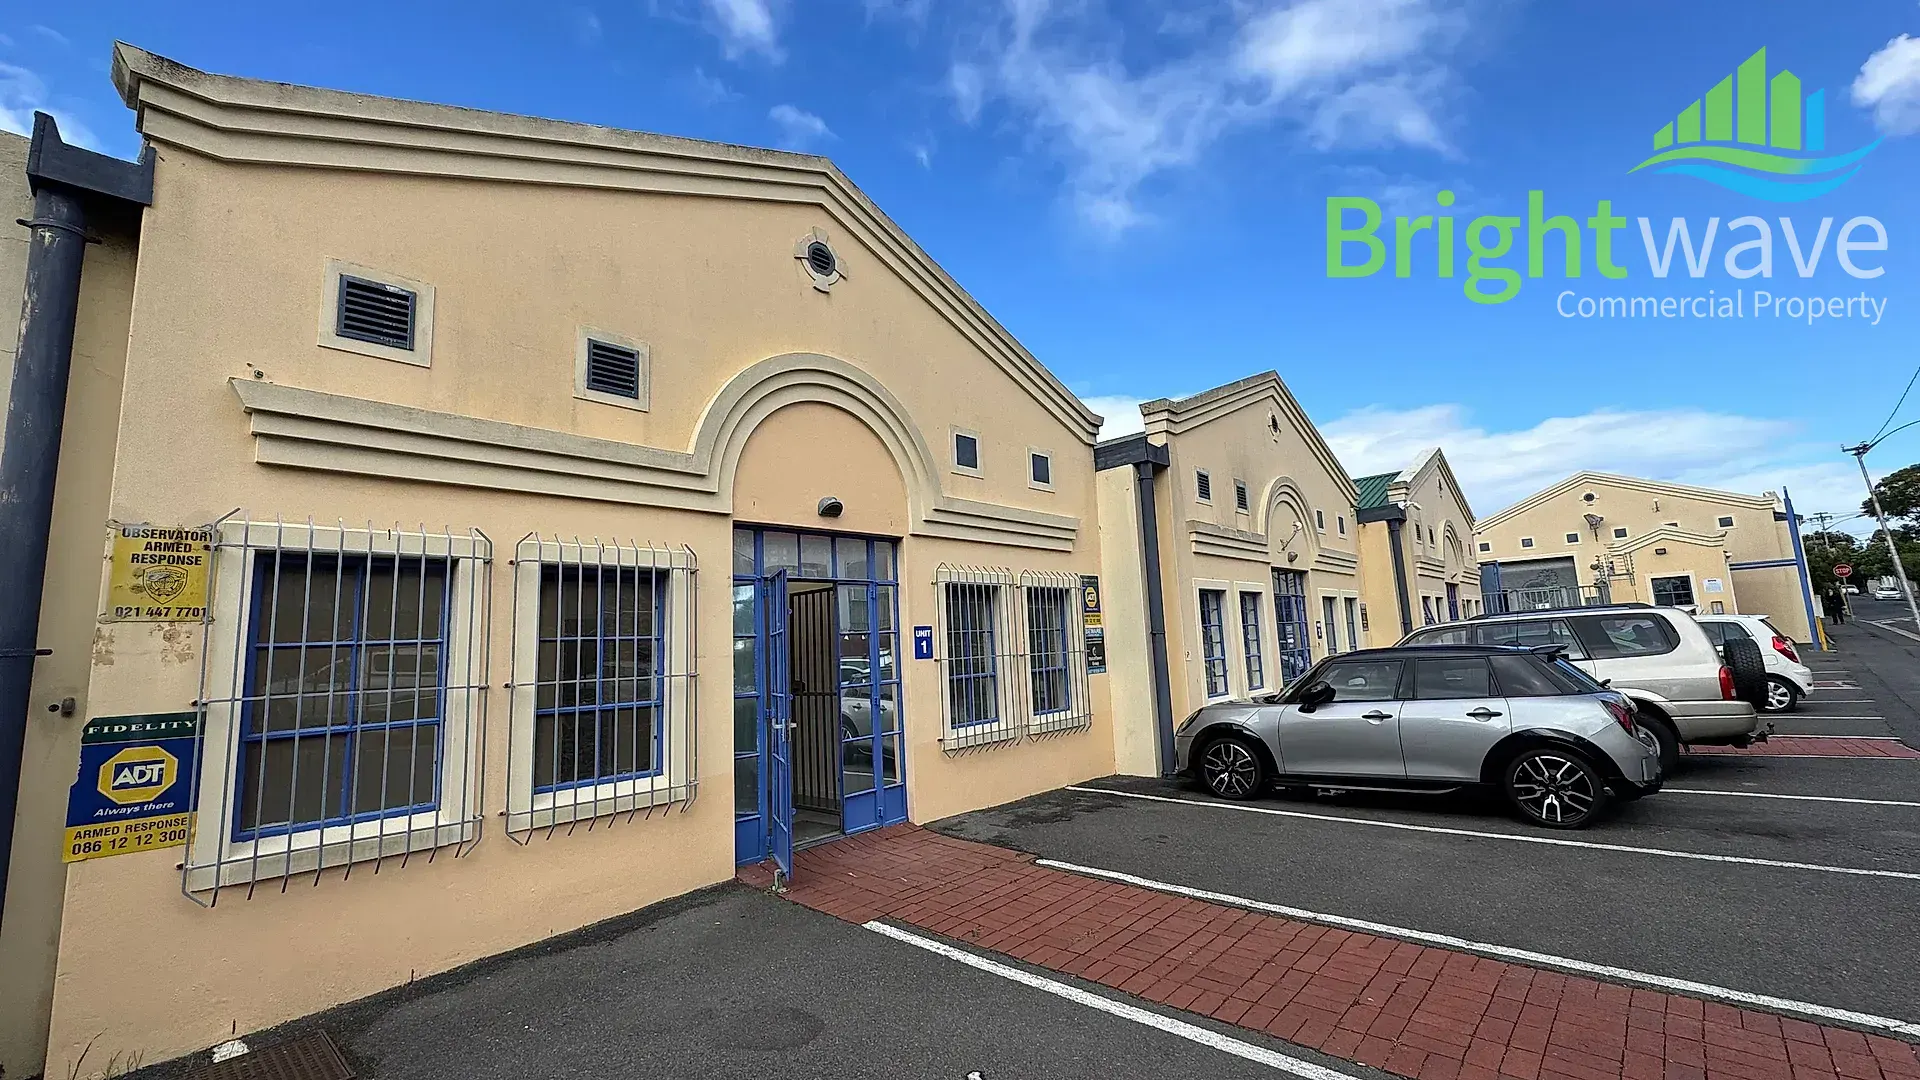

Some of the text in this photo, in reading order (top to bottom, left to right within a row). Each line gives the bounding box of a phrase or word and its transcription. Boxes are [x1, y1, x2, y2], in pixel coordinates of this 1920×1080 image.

[144, 541, 192, 552] ARMED
[130, 553, 202, 565] RESPONSE
[115, 607, 206, 618] 021 447 7701
[916, 630, 931, 638] UNIT
[921, 640, 927, 653] 1
[87, 720, 197, 734] FIDELITY
[113, 763, 165, 786] ADT
[94, 801, 175, 817] Always there
[74, 817, 188, 840] ARMED RESPONSE
[71, 828, 186, 855] 086 12 12 300
